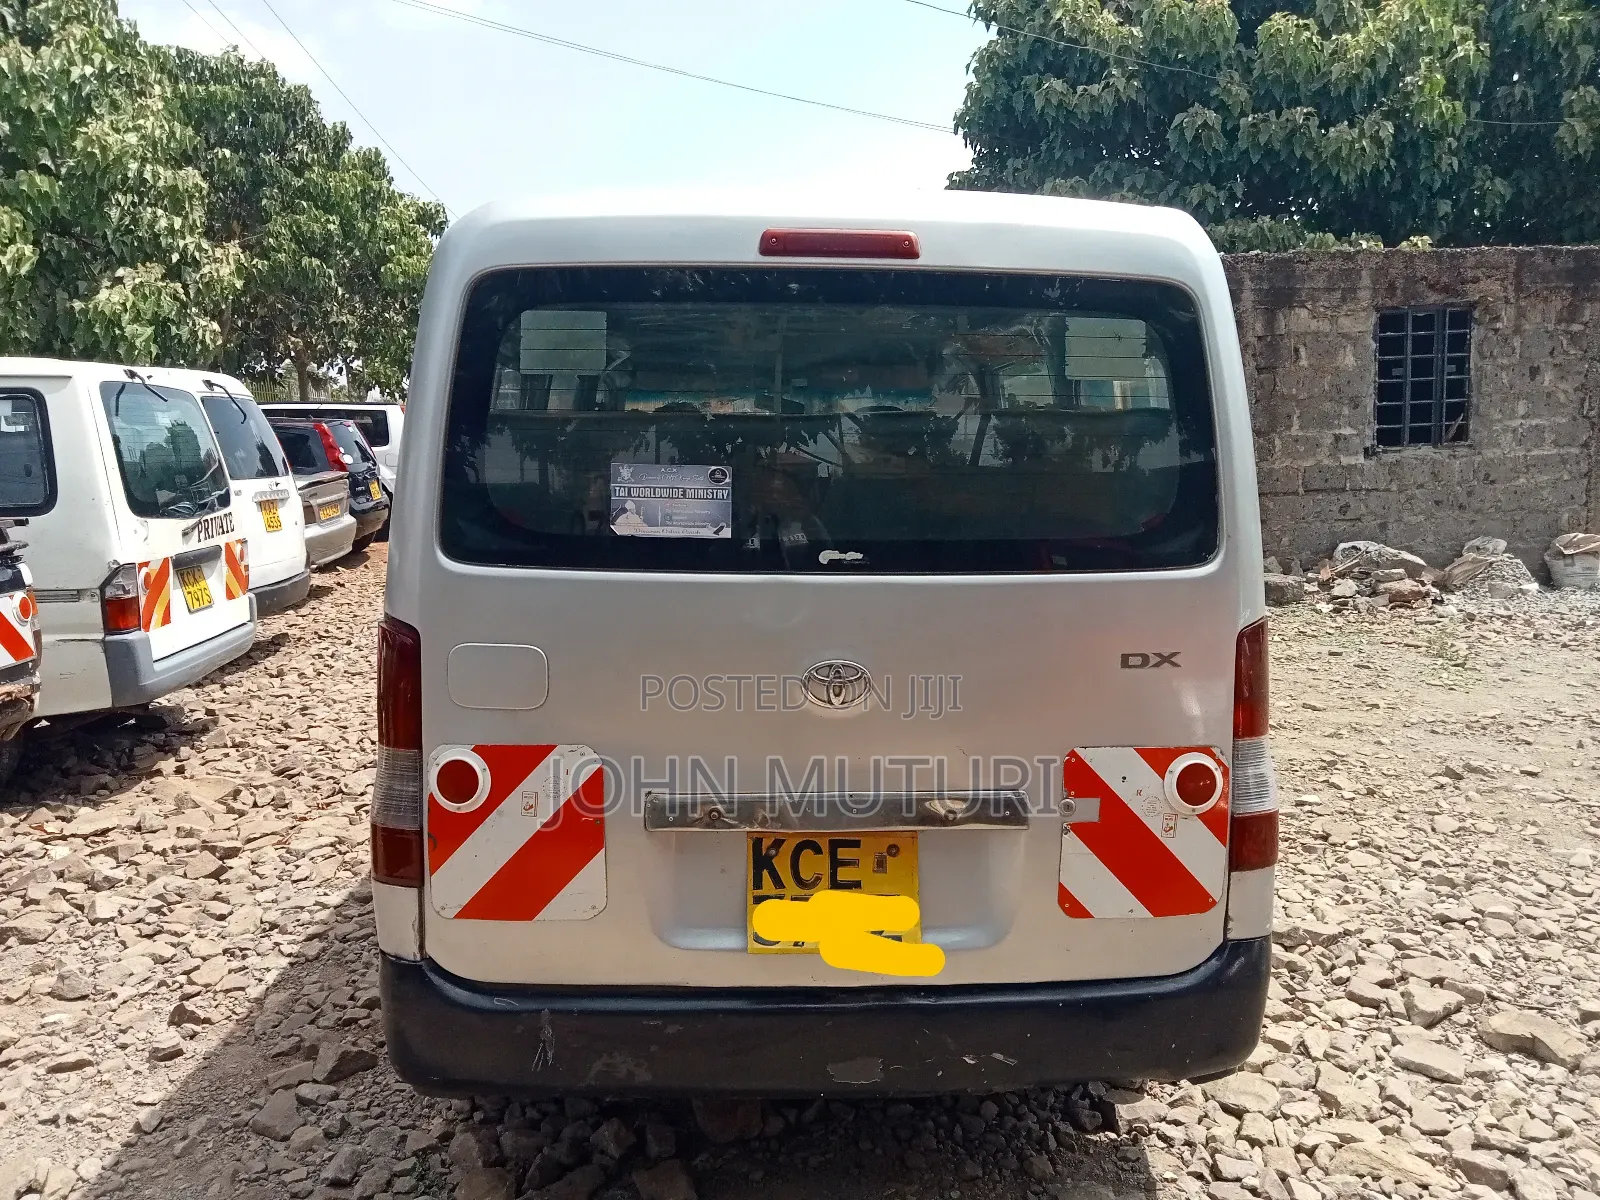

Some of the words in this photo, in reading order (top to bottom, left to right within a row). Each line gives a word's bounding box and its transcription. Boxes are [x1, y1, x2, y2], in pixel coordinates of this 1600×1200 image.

[614, 486, 628, 497] TAI
[630, 487, 684, 498] WORLDWIDE
[686, 488, 729, 500] MINISTRY
[197, 512, 235, 543] PRIVATE
[180, 569, 202, 590] KCK
[187, 587, 212, 610] 797S
[1121, 651, 1182, 669] DX
[752, 837, 862, 891] KCE
